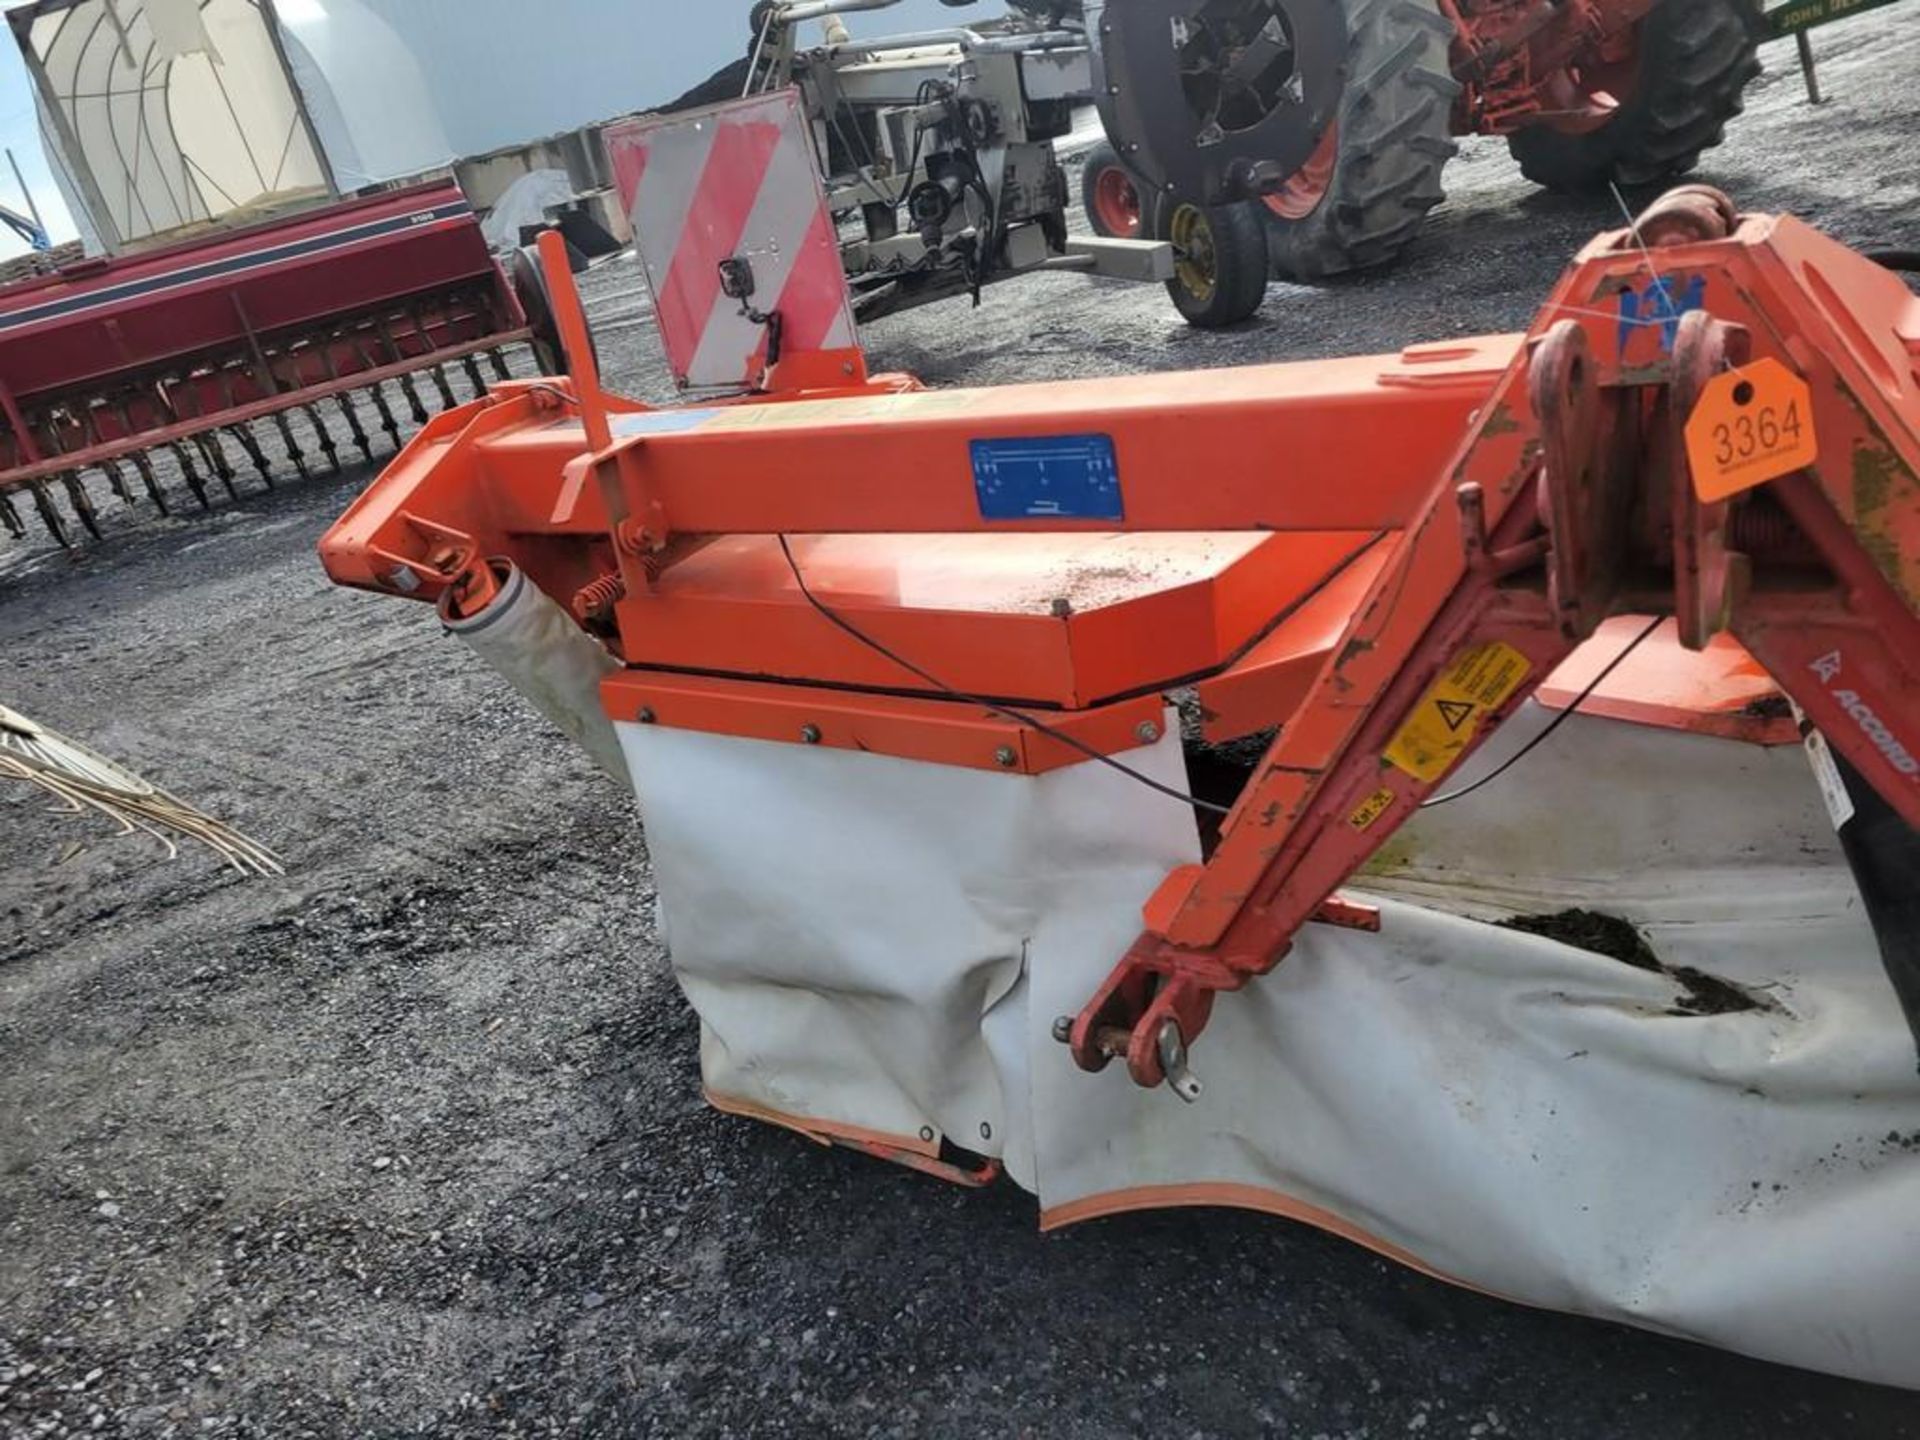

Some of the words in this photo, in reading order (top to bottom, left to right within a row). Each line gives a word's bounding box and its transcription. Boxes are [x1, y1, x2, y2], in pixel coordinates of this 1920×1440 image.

[1781, 4, 1823, 28] JOHN
[1712, 398, 1801, 465] 3364
[1831, 689, 1918, 773] ACCORD
